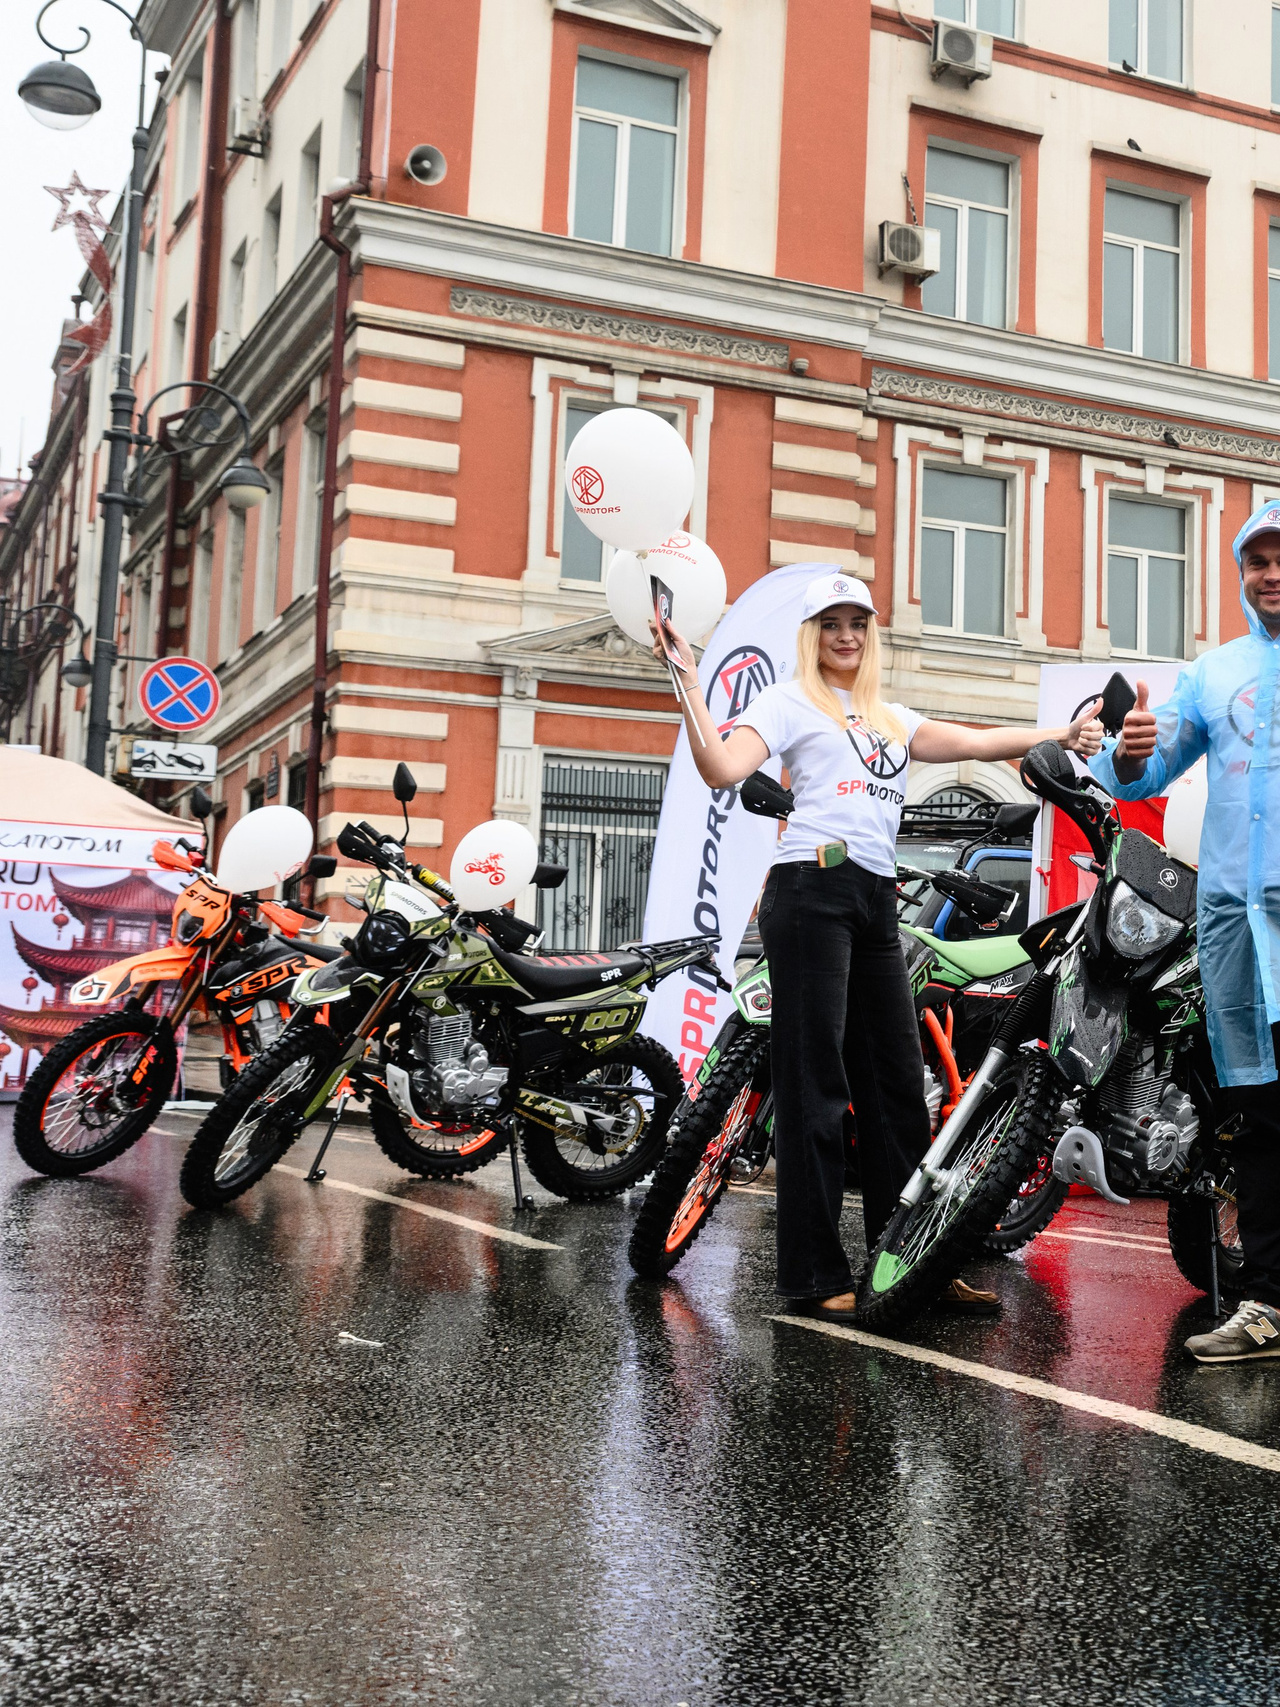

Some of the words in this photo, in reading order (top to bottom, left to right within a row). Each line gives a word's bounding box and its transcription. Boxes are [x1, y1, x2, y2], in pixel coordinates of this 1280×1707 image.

[648, 548, 698, 565] RMOTORS
[186, 889, 221, 910] SPR
[600, 967, 622, 982] SPR
[986, 973, 1015, 998] MAX
[131, 1045, 158, 1085] SPR
[687, 1045, 721, 1102] SPR
